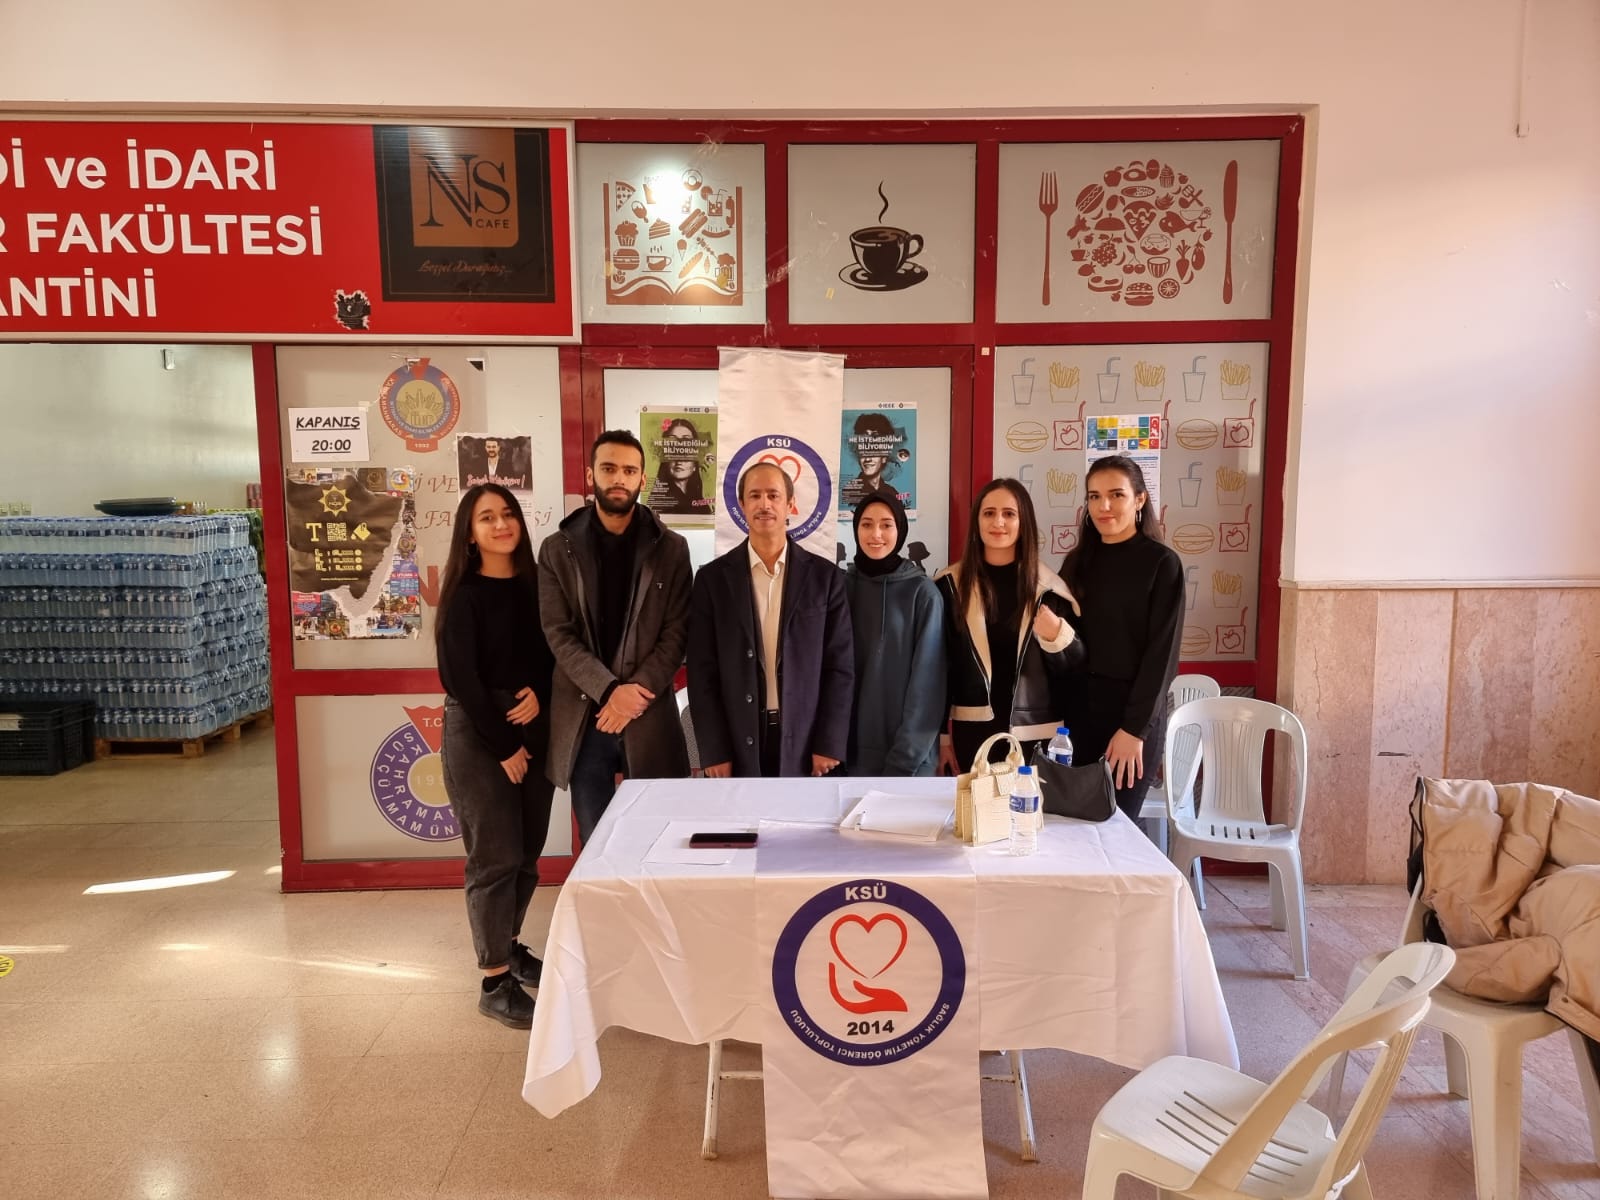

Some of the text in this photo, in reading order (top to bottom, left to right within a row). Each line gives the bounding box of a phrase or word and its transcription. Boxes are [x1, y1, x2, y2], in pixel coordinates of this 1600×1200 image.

[0, 138, 277, 191] İ ve İDARİ
[414, 153, 511, 228] NS
[27, 204, 323, 255] FAKÜLTESİ
[475, 219, 511, 229] CAFE
[0, 268, 157, 317] NTİNİ
[296, 416, 361, 431] KAPANIŞ
[312, 439, 352, 451] 20:00
[767, 437, 791, 448] KSÜ
[422, 717, 443, 728] T.C
[845, 883, 887, 901] KSÜ
[790, 1003, 950, 1059] SAĞLIK YÖNETİM ÖĞRENCİ TOPLULUĞU
[847, 1020, 895, 1036] 2014
